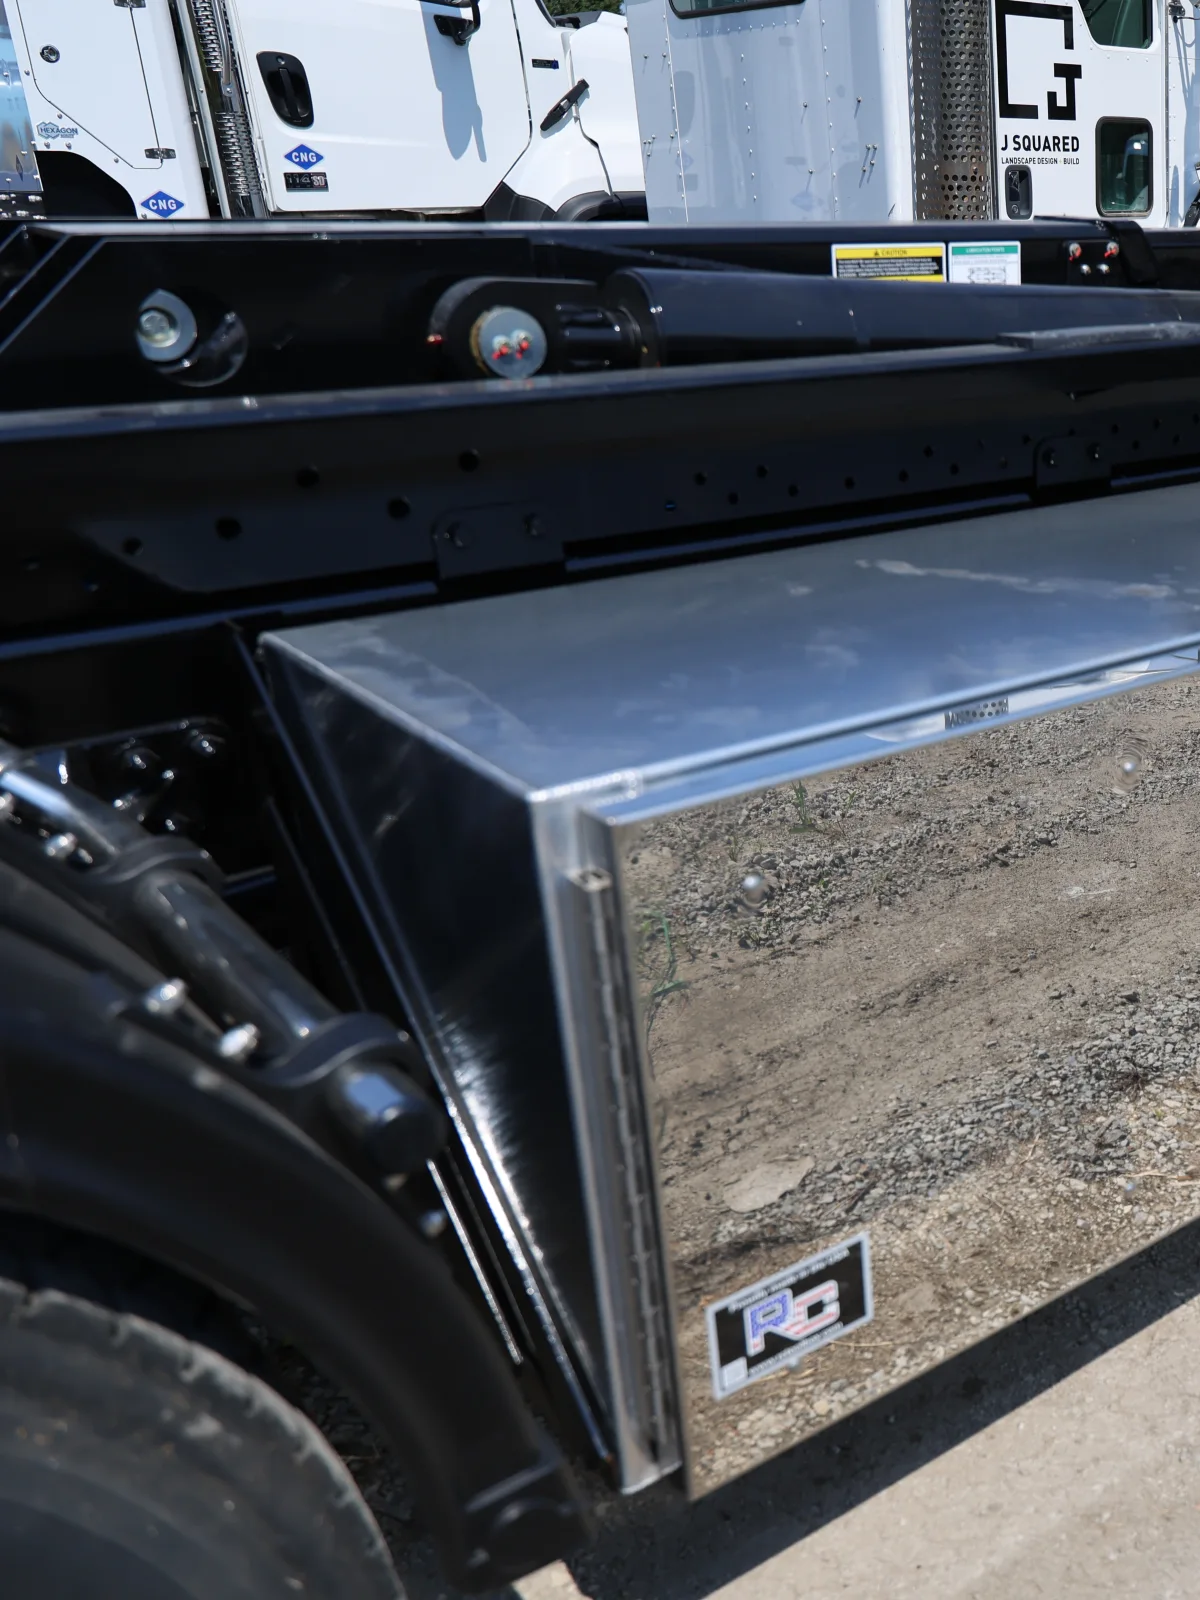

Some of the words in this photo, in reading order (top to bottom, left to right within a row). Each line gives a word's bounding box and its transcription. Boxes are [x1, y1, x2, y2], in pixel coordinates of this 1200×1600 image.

[40, 127, 79, 135] HEXAGON
[1000, 134, 1009, 151] J
[1012, 134, 1080, 152] SQUARED
[291, 151, 317, 163] CNG
[1001, 157, 1037, 165] LANDSCAPE
[1037, 157, 1058, 165] DESIGN
[1063, 157, 1080, 165] BUILD
[149, 200, 177, 211] CNG
[743, 1279, 841, 1357] RC
